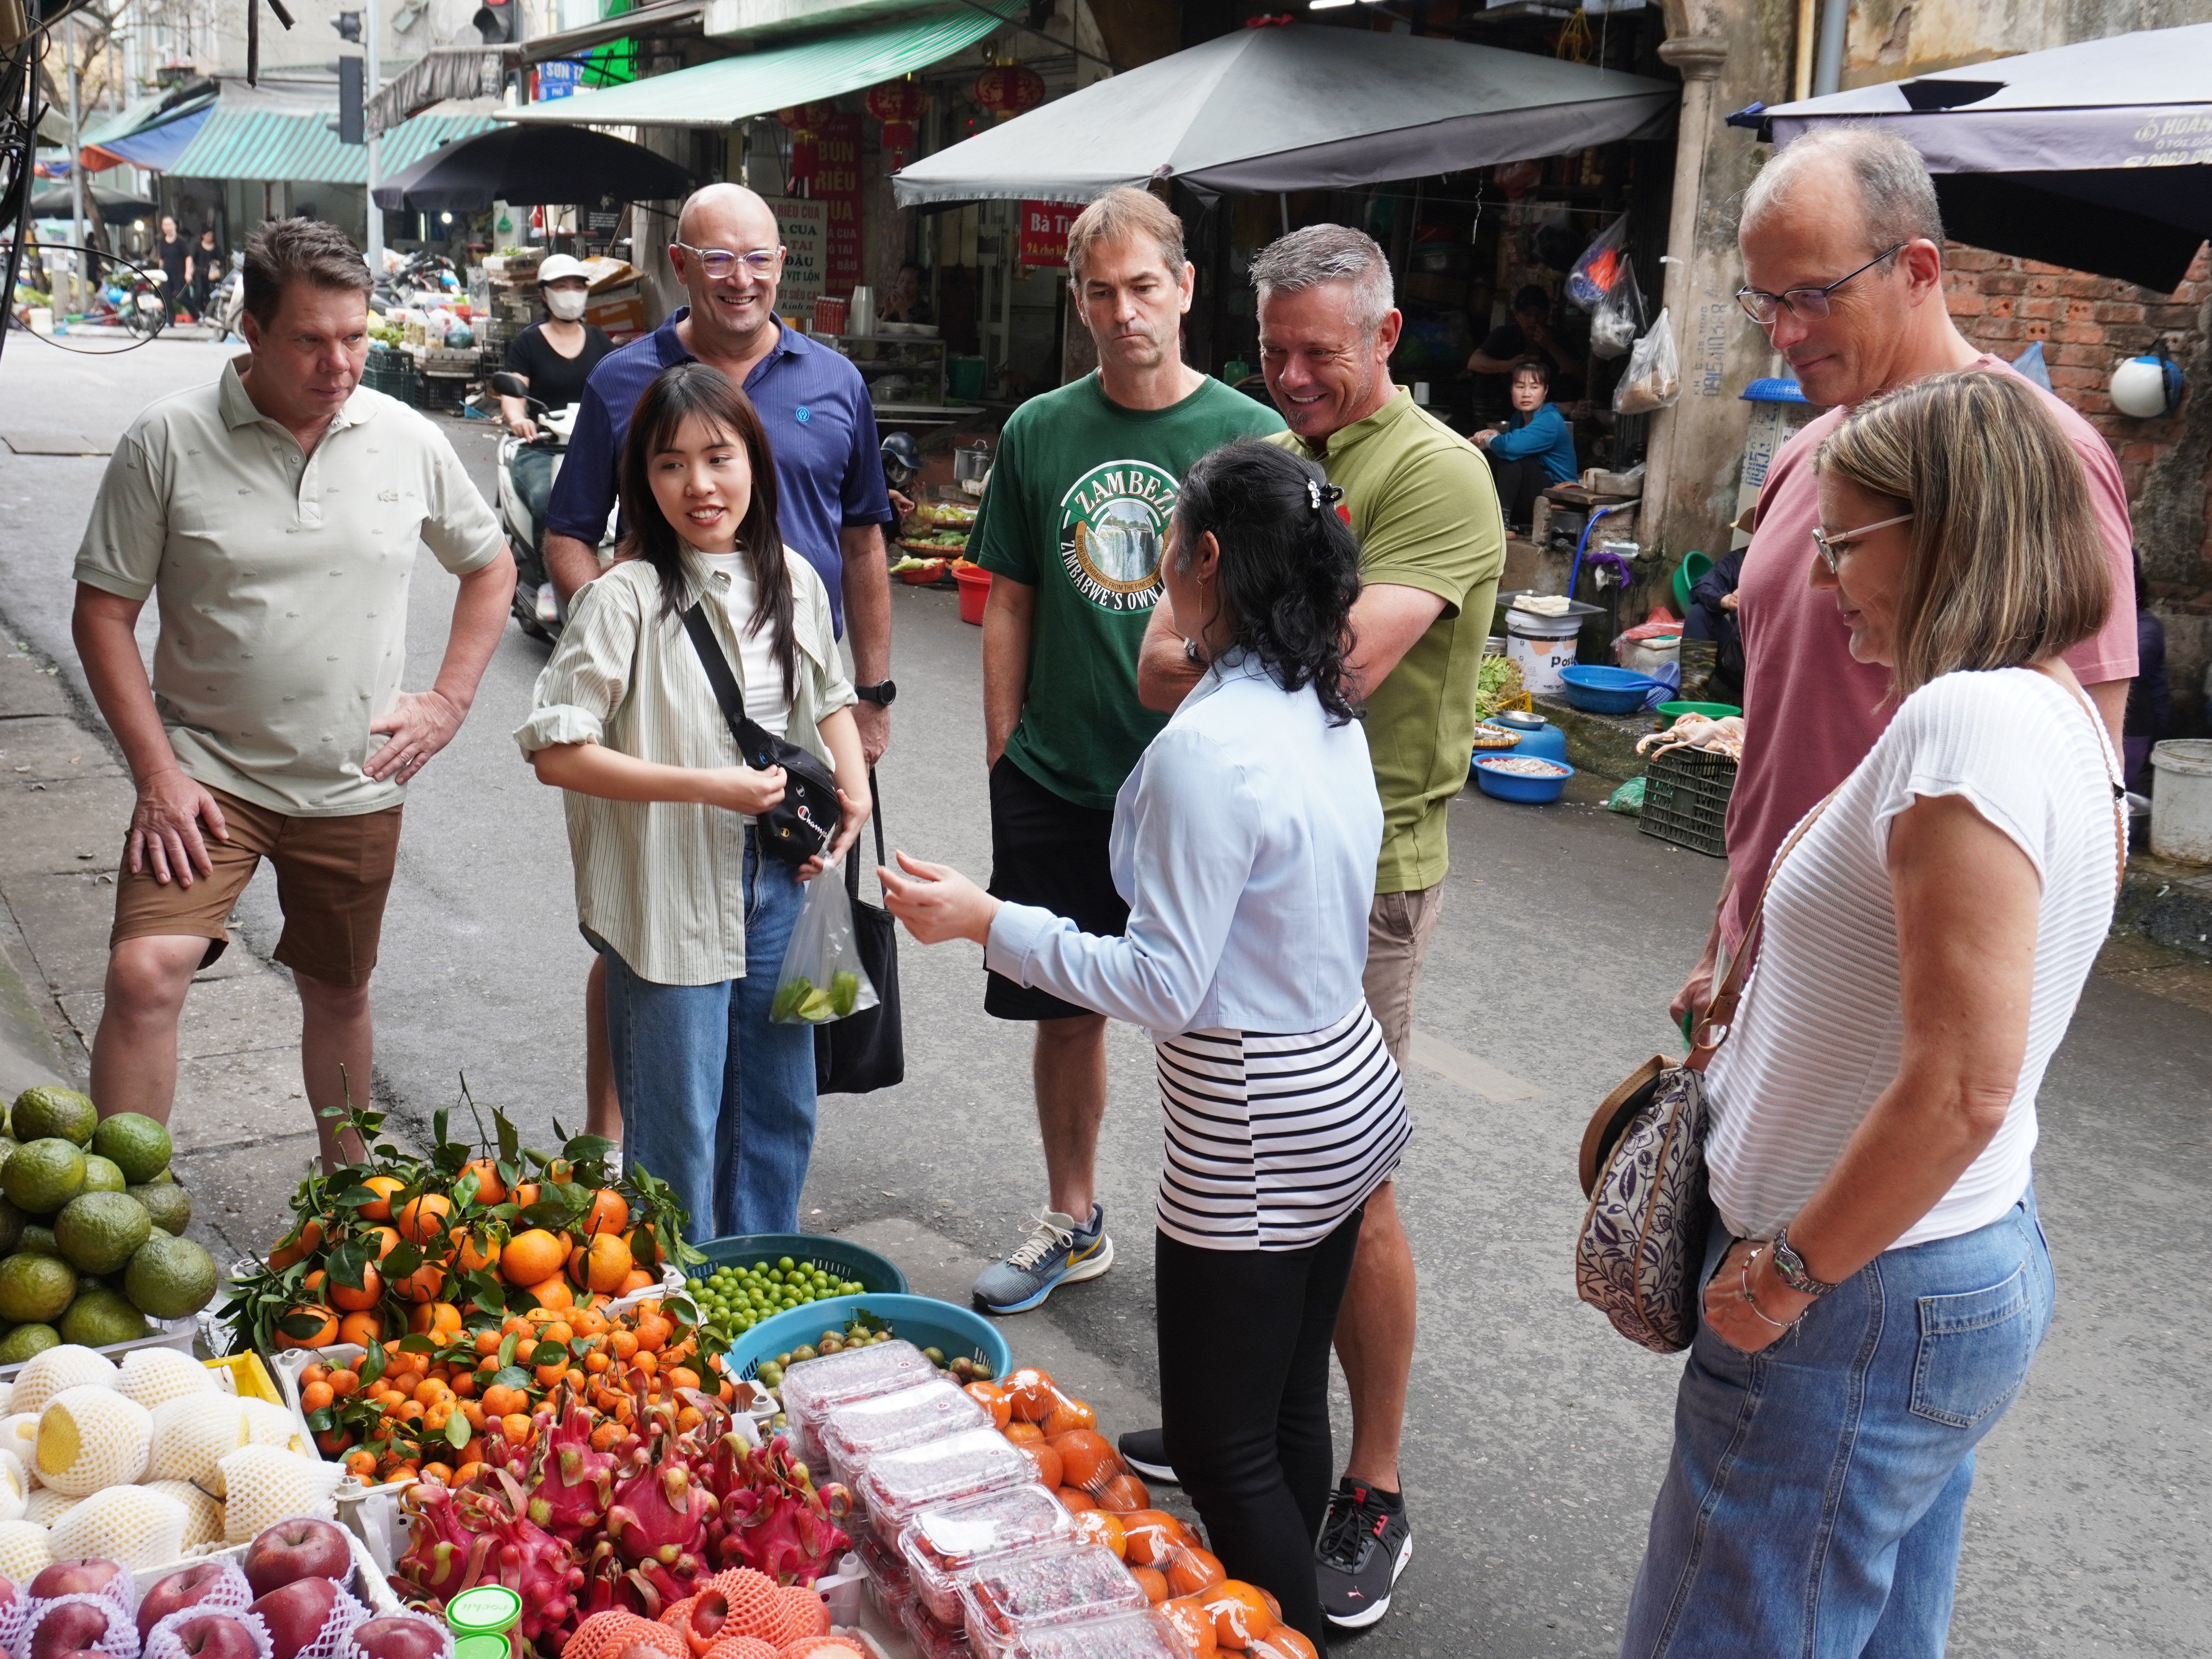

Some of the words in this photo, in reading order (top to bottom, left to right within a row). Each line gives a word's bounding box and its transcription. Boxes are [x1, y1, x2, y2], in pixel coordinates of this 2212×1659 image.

[818, 138, 854, 162] BÚN
[802, 205, 820, 219] CUA
[789, 224, 818, 236] CUA
[1031, 213, 1050, 233] Bà
[790, 241, 814, 251] TAI
[786, 271, 801, 282] VỊT
[1077, 535, 1085, 557] BREWED
[1085, 563, 1108, 586] ZIMBABWE
[1108, 582, 1123, 591] FROM
[1135, 579, 1153, 590] FINEST
[1127, 587, 1160, 610] OWN
